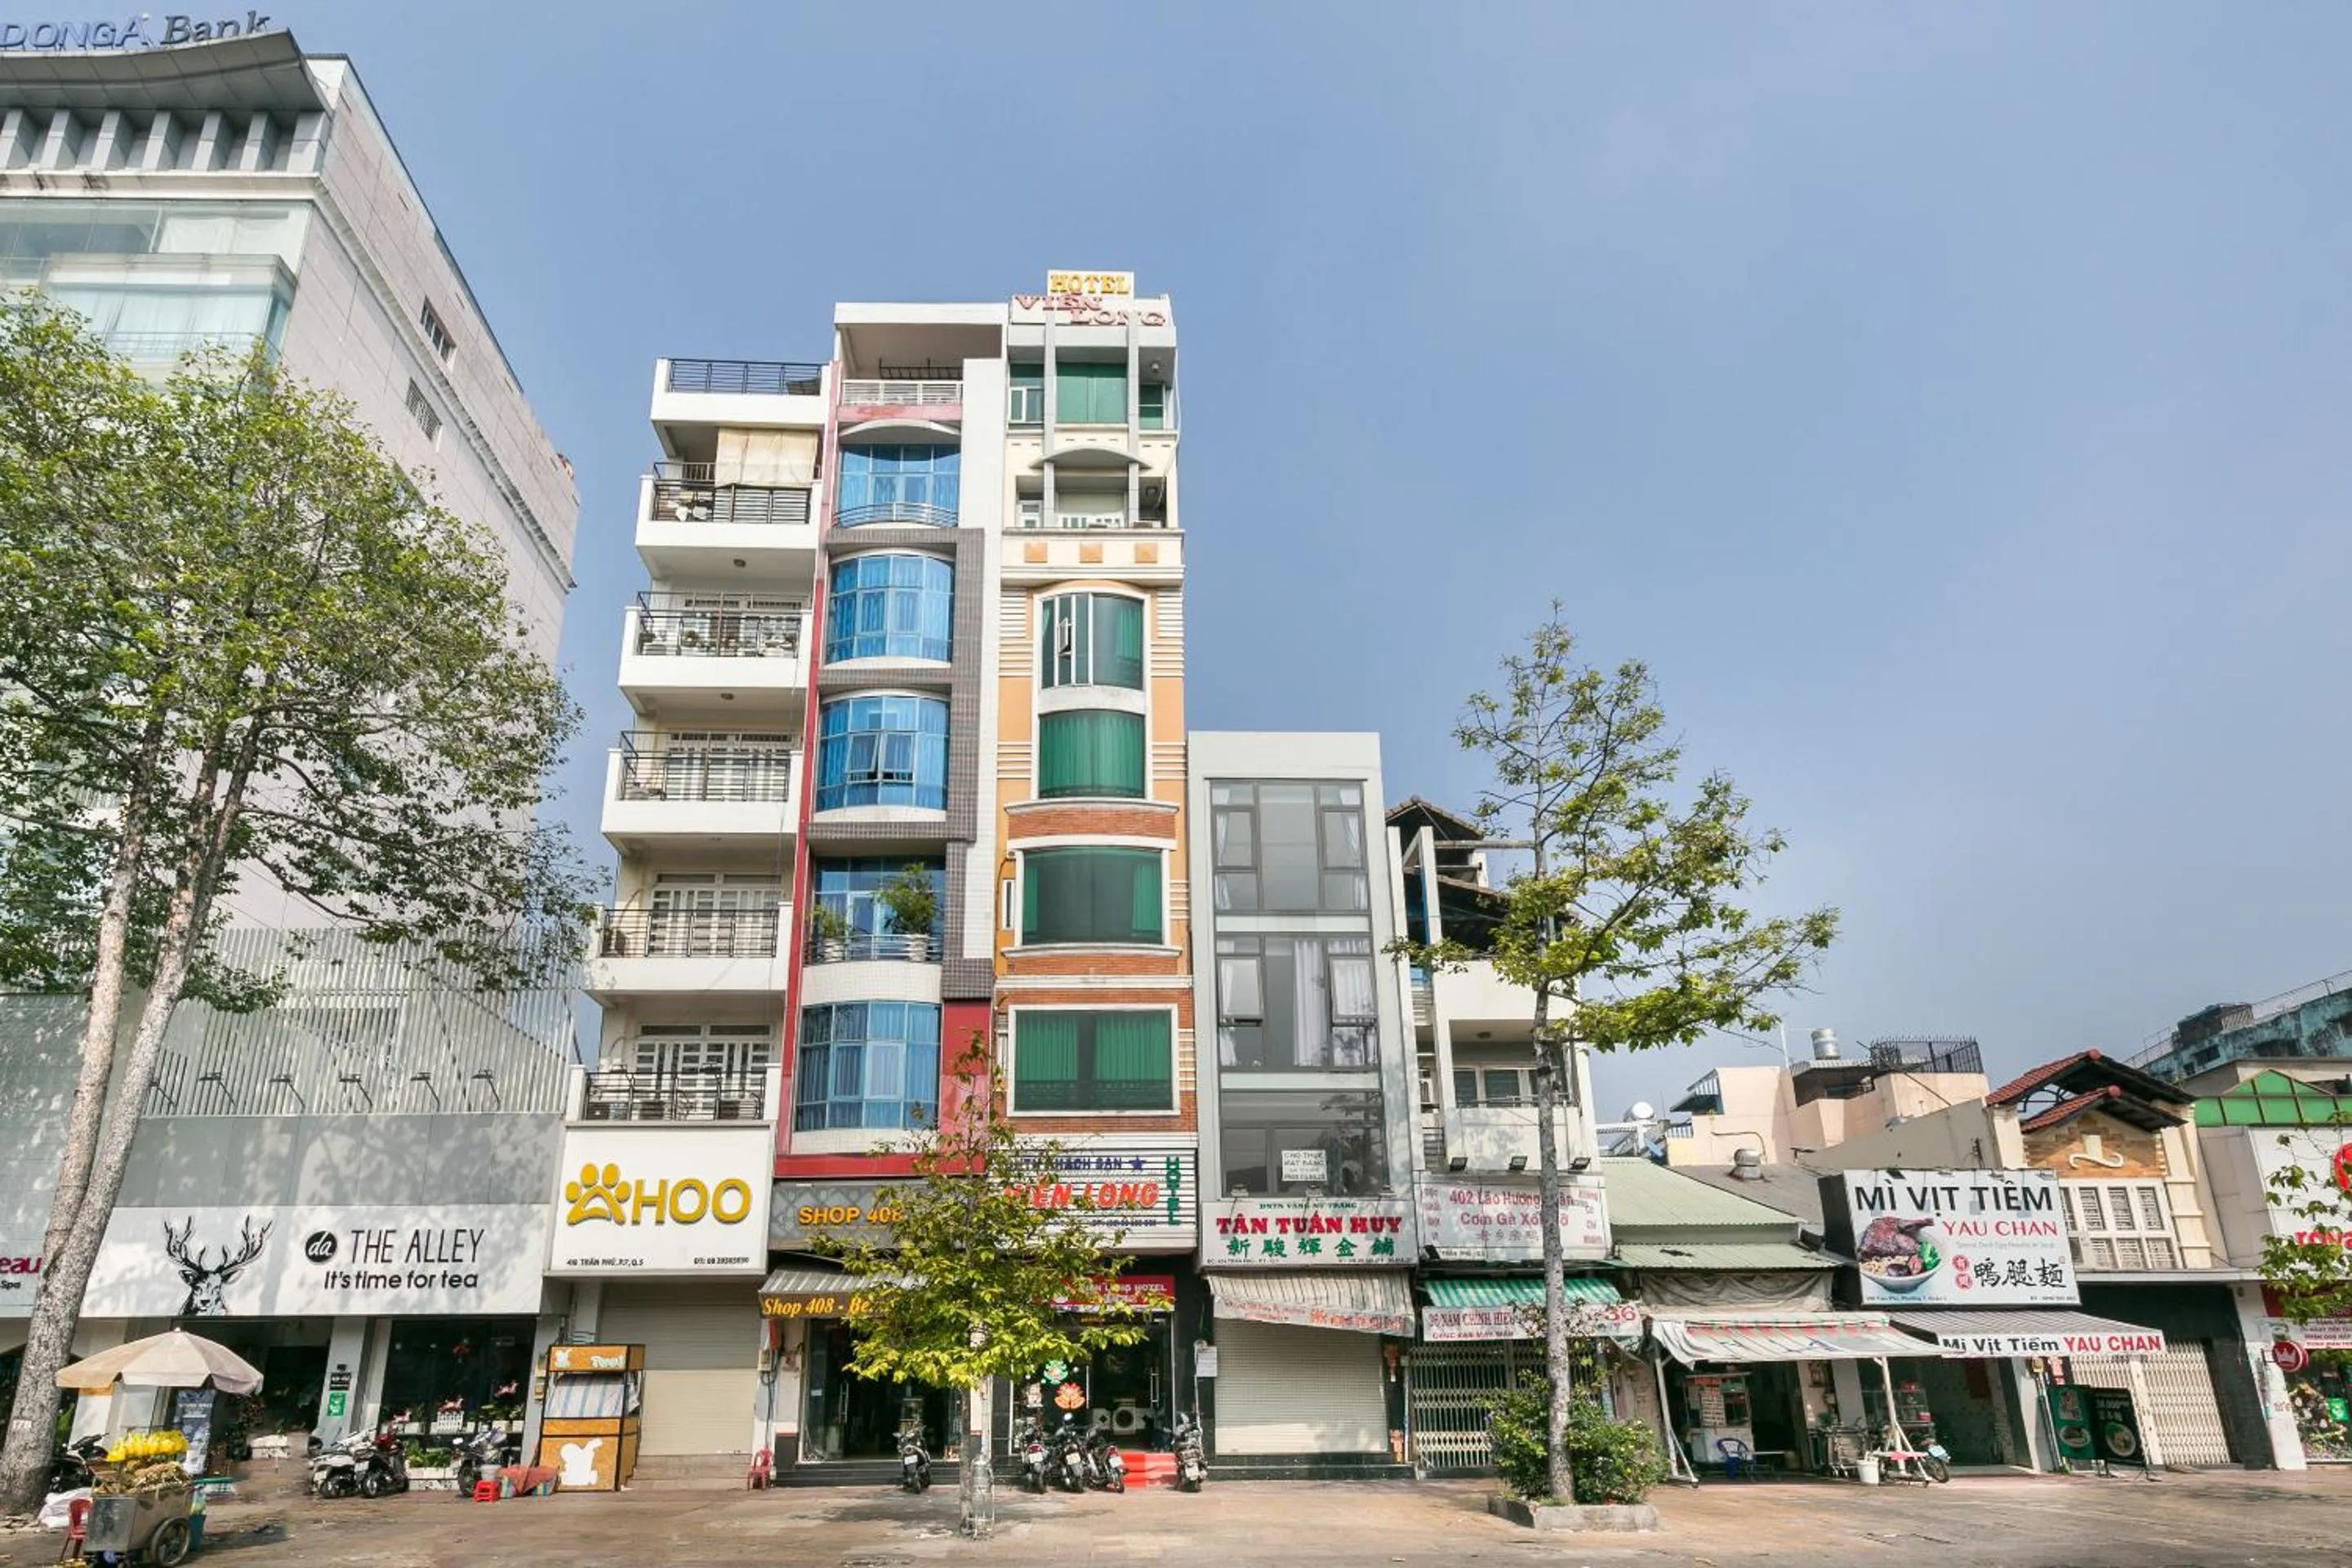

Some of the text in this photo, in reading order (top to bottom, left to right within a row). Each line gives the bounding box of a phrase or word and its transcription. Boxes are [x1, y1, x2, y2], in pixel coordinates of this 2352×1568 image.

[161, 11, 270, 44] Bank
[1050, 275, 1129, 294] HOTEL
[1165, 1156, 1182, 1225] HOTEL
[1450, 1190, 1473, 1205] 402
[1855, 1179, 1897, 1211] MÌ
[1906, 1186, 1959, 1217] VỊT
[798, 1205, 903, 1224] SHOP 408
[1216, 1213, 1268, 1234] TÂN
[1350, 1216, 1403, 1234] HUY
[1942, 1220, 2059, 1236] YAU CHAN
[350, 1229, 397, 1263] THE
[404, 1229, 484, 1263] ALLEY
[0, 1257, 42, 1274] eau
[324, 1270, 479, 1290] It's time for tea
[763, 1297, 801, 1319] Shop
[806, 1297, 835, 1314] 408
[1971, 1339, 2001, 1356] Vịt
[2063, 1336, 2103, 1352] YAU
[2108, 1335, 2162, 1352] CHAN
